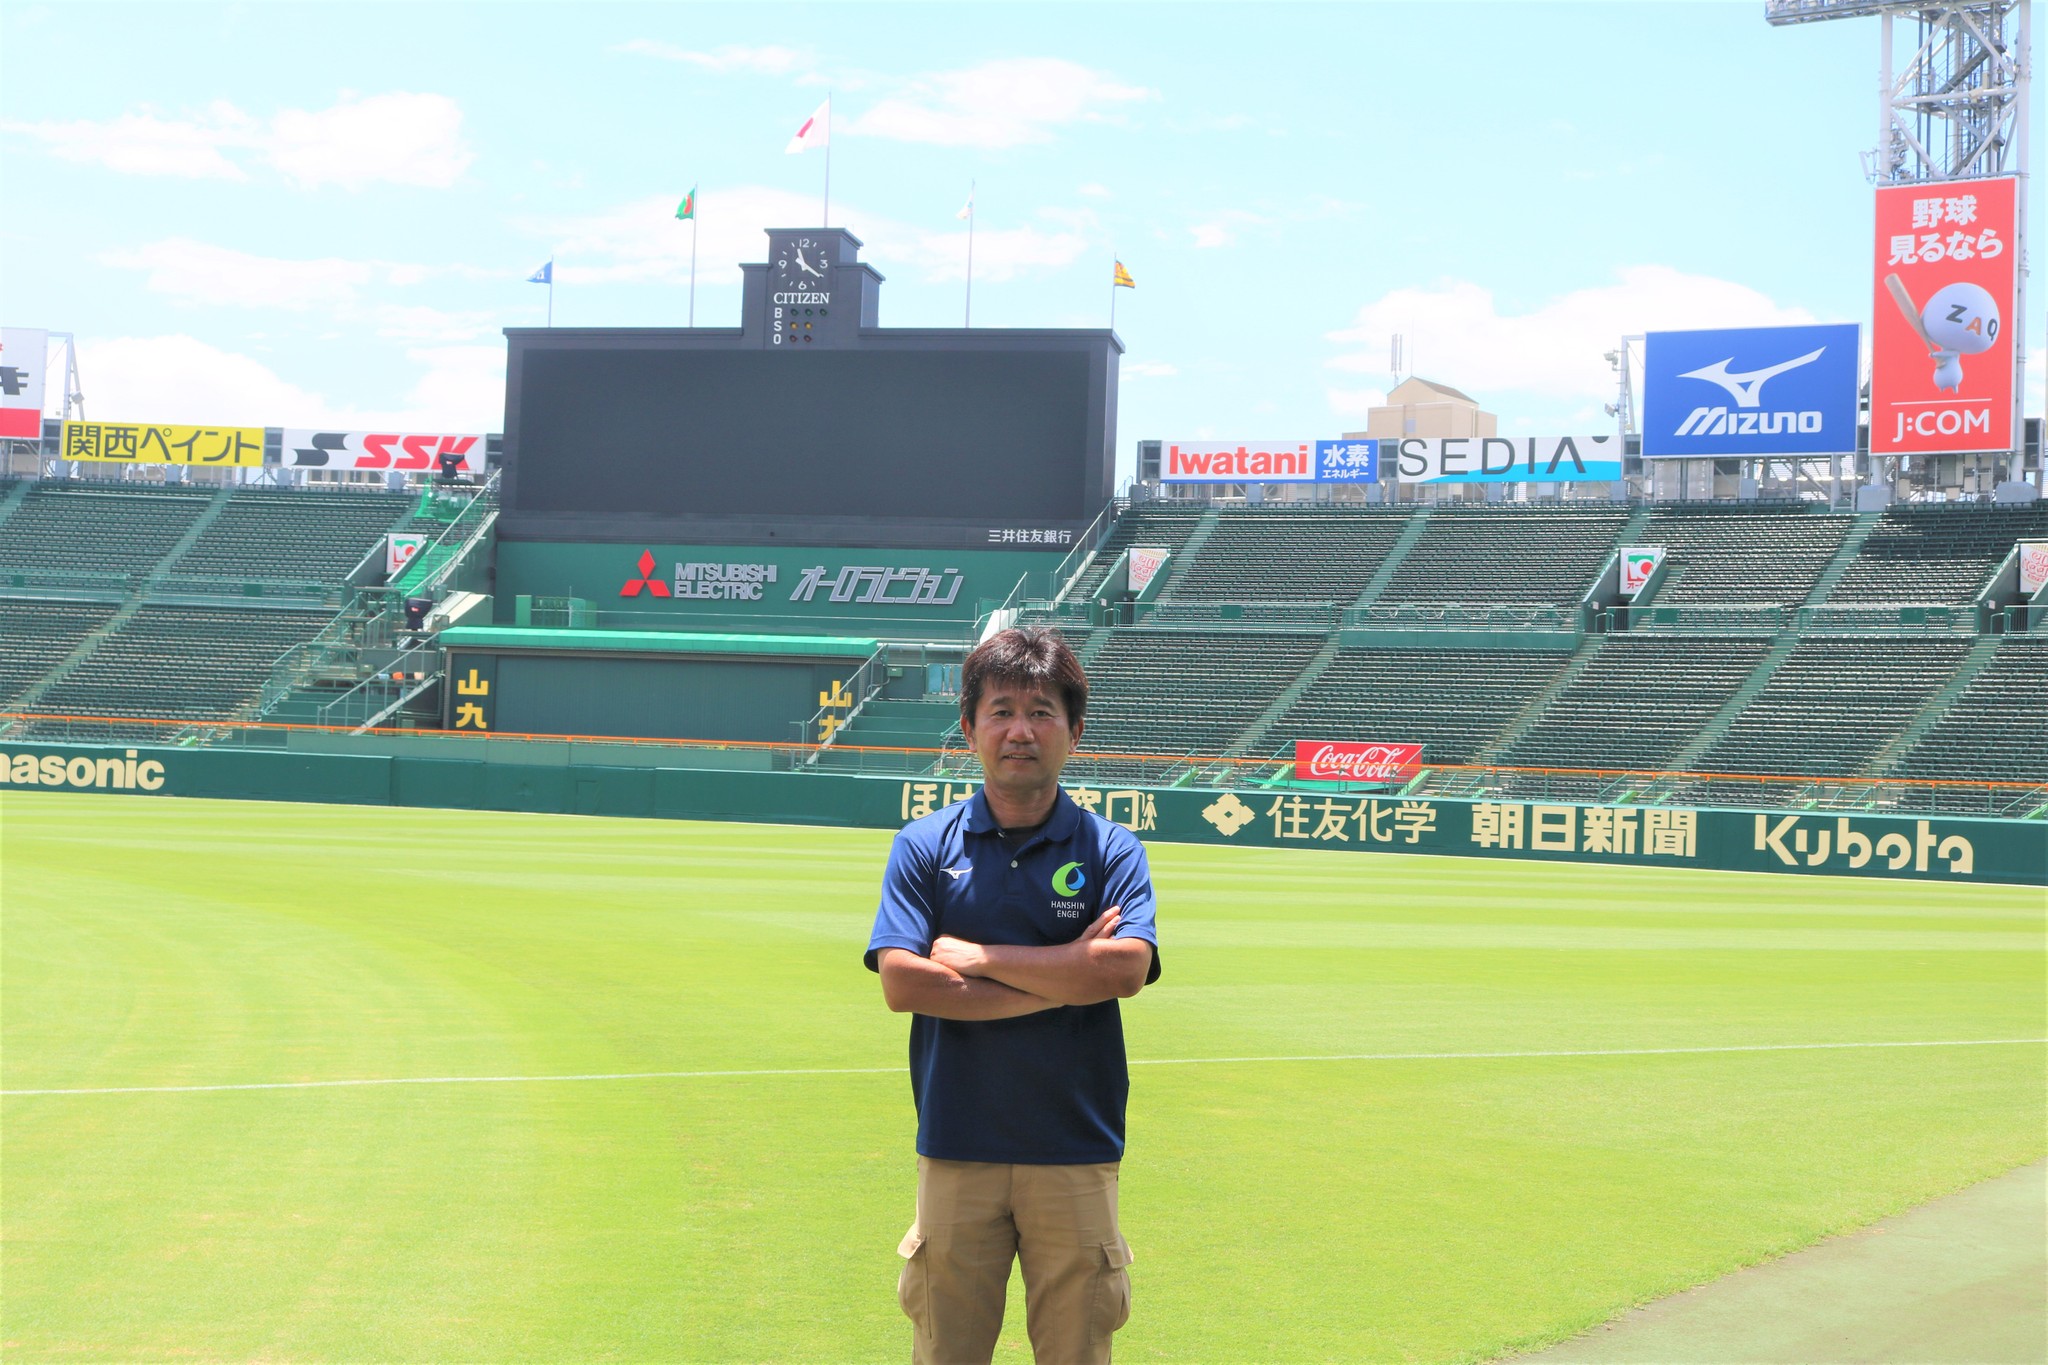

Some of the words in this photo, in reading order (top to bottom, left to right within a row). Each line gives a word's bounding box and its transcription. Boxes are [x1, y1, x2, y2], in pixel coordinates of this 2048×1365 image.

[1912, 195, 1977, 229] 野球
[799, 239, 810, 248] 12
[1887, 228, 2003, 266] 見るなら
[778, 259, 787, 269] 9
[820, 259, 828, 269] 3
[773, 292, 830, 304] CITIZEN
[798, 281, 807, 290] 6
[773, 320, 782, 331] S
[774, 307, 783, 318] B
[1891, 409, 1990, 443] J:COM
[66, 424, 261, 464] 関西ペイント
[353, 433, 479, 470] SSK
[1322, 444, 1370, 467] 水素
[1399, 436, 1587, 476] SEDIA
[1169, 444, 1308, 475] Iwatani
[1322, 468, 1369, 479] エネルギー
[988, 529, 1072, 544] 三井住友銀行
[675, 563, 777, 583] MITSUBISHI
[789, 566, 964, 605] オーロラビジョン
[674, 581, 763, 600] ELECTRIC
[455, 669, 489, 729] 山九
[1310, 745, 1406, 779] Coca-Cola
[1267, 795, 1437, 844] 住友化学
[1471, 802, 1696, 857] 朝日新聞
[1754, 814, 1975, 874] Kubota
[1051, 901, 1085, 910] HANSHIN
[1057, 910, 1080, 918] ENGEI
